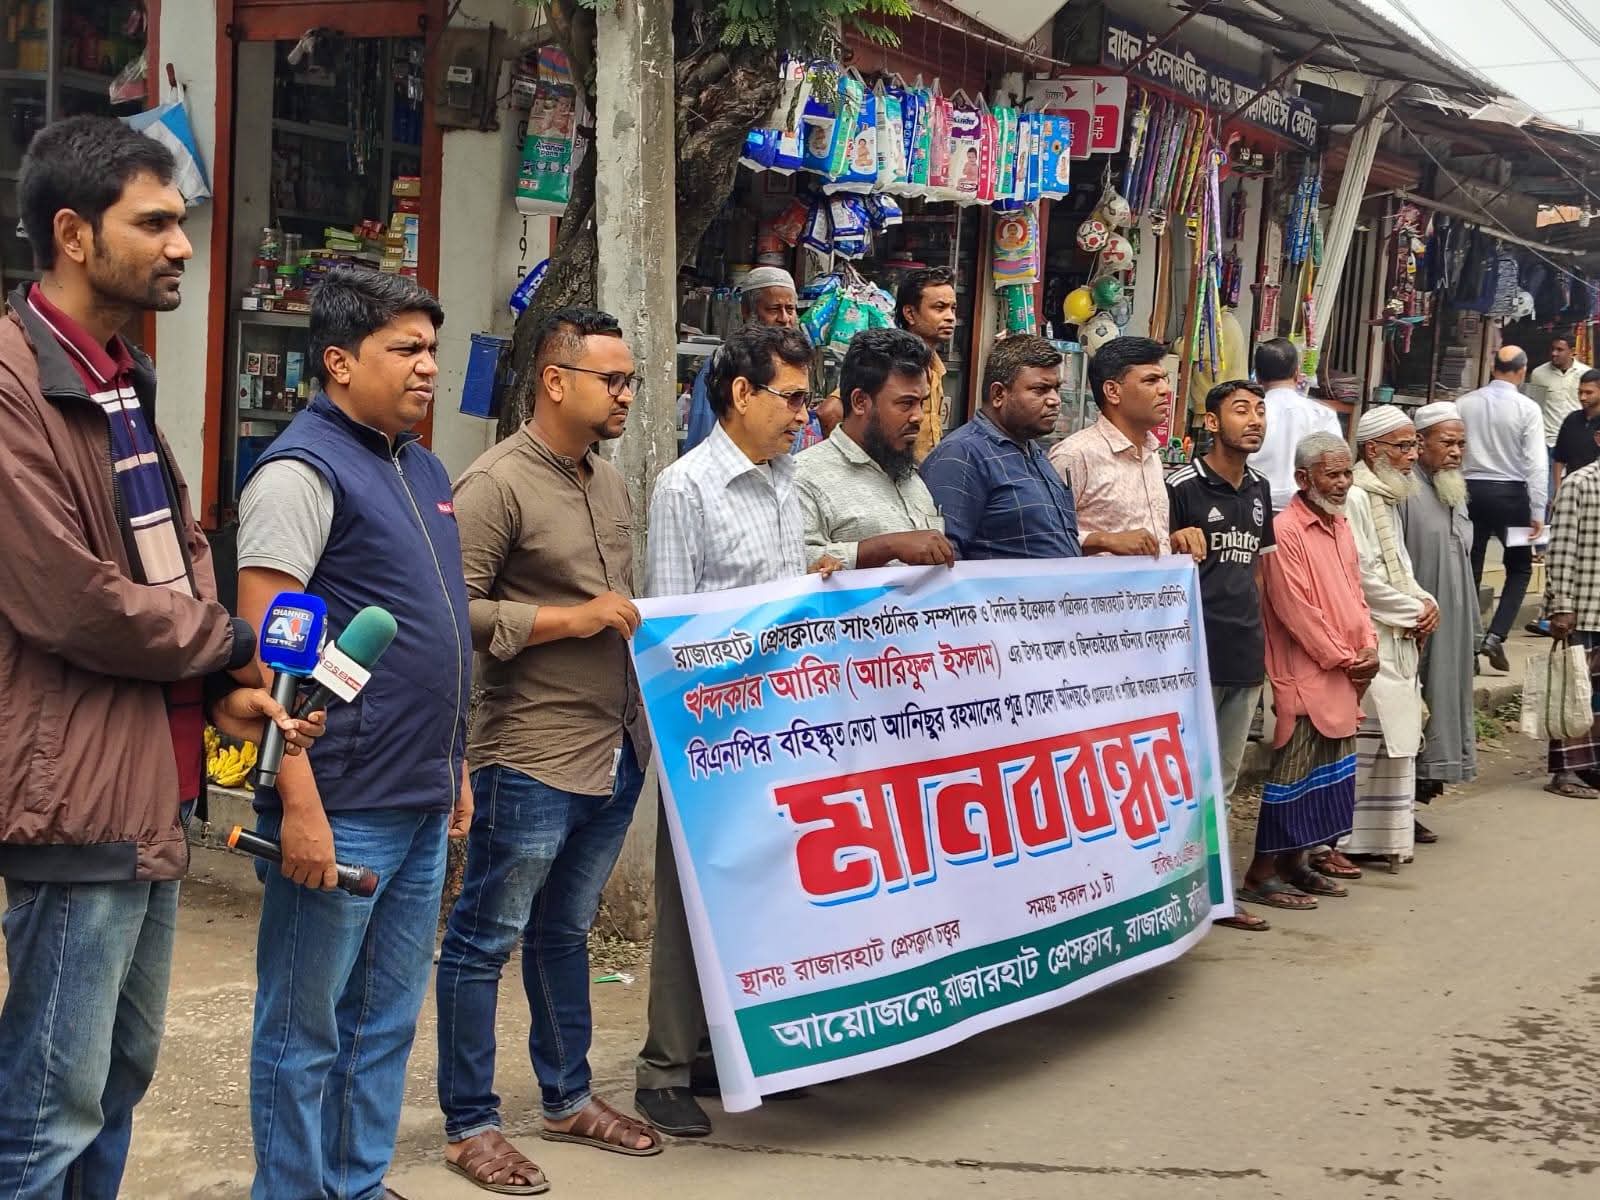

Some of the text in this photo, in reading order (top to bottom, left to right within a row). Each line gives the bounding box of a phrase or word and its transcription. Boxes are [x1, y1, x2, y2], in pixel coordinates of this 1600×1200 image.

[272, 608, 311, 621] CHANNEL
[672, 632, 753, 669] রাজারহাট
[760, 619, 836, 654] প্রেসক্লাবের
[840, 605, 919, 640] সাংগঠনিক
[923, 605, 977, 630] সম্পাদক
[981, 605, 989, 622] ও
[986, 596, 1018, 623] দৈনিক
[1018, 595, 1056, 621] ইত্তেফাক
[685, 675, 763, 720] খন্দকার
[768, 655, 841, 701] আরিফ
[846, 645, 938, 701] (আরিফুল
[938, 639, 1002, 680] ইসলাম)
[1008, 645, 1022, 664] এর
[1069, 640, 1077, 657] ও
[687, 729, 772, 779] বিএনপির
[848, 714, 878, 747] নেতা
[880, 702, 946, 743] আনিছুর
[947, 697, 1003, 730] রহমানের
[1004, 694, 1024, 727] পুত্র
[773, 712, 1197, 902] মানববন্ধন
[1026, 872, 1115, 918] সময়ঃ সকাল ১১ টা
[736, 965, 786, 997] স্থানঃ
[792, 936, 885, 982] রাজারহাট
[890, 927, 936, 960] প্রেসক্লাব
[770, 985, 942, 1050] আয়োজনেঃ
[940, 945, 1041, 1008] রাজারহাট
[1047, 925, 1122, 977] প্রেসক্লাব,
[1123, 893, 1188, 945] রাজারহাট,
